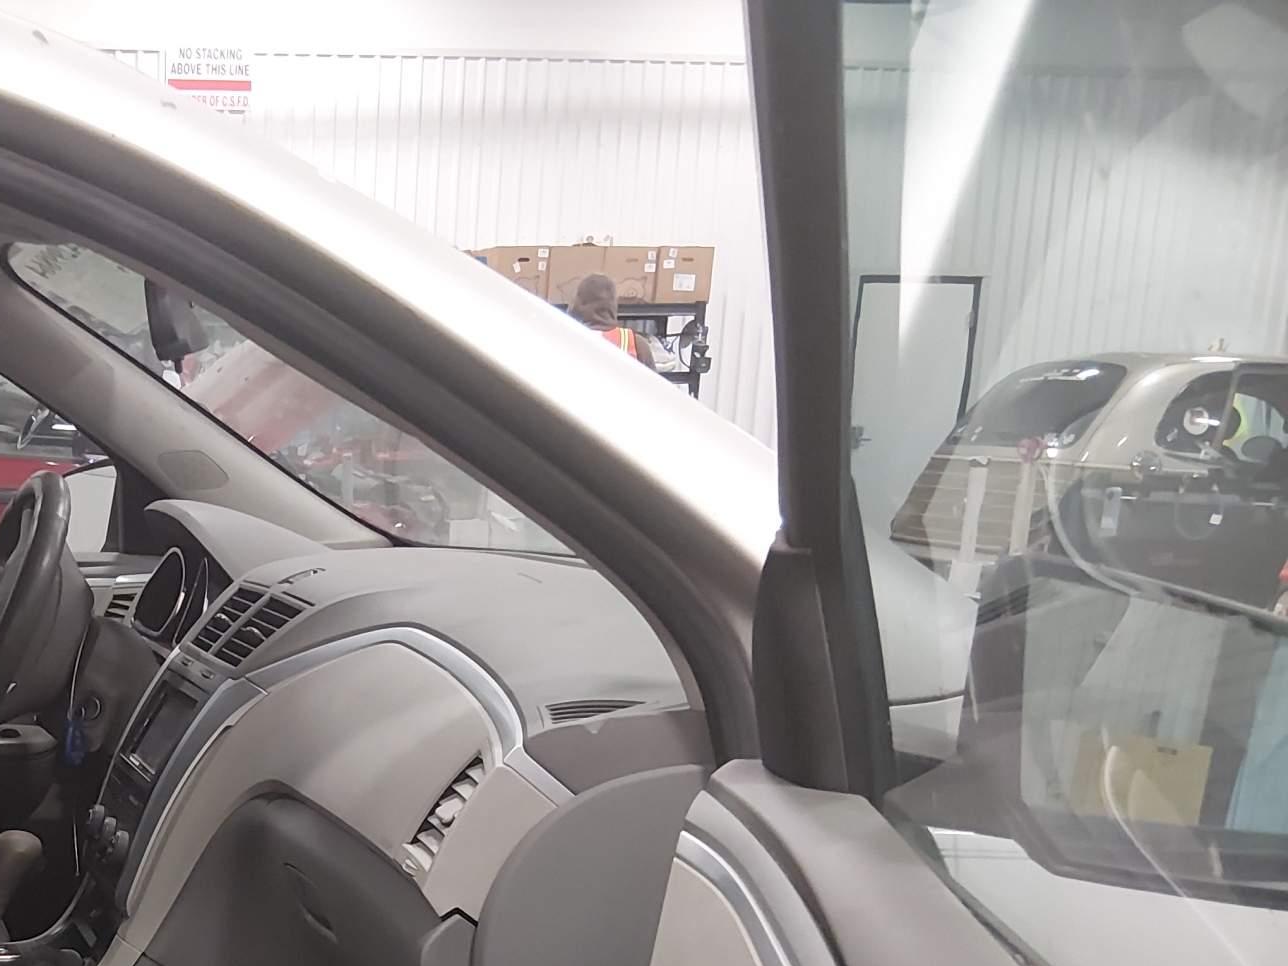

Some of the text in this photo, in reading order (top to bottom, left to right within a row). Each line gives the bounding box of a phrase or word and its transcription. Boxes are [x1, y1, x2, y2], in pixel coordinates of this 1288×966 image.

[178, 47, 243, 60] NO STACKING
[171, 63, 250, 76] ABOVE THIS LINE
[209, 96, 220, 106] OF
